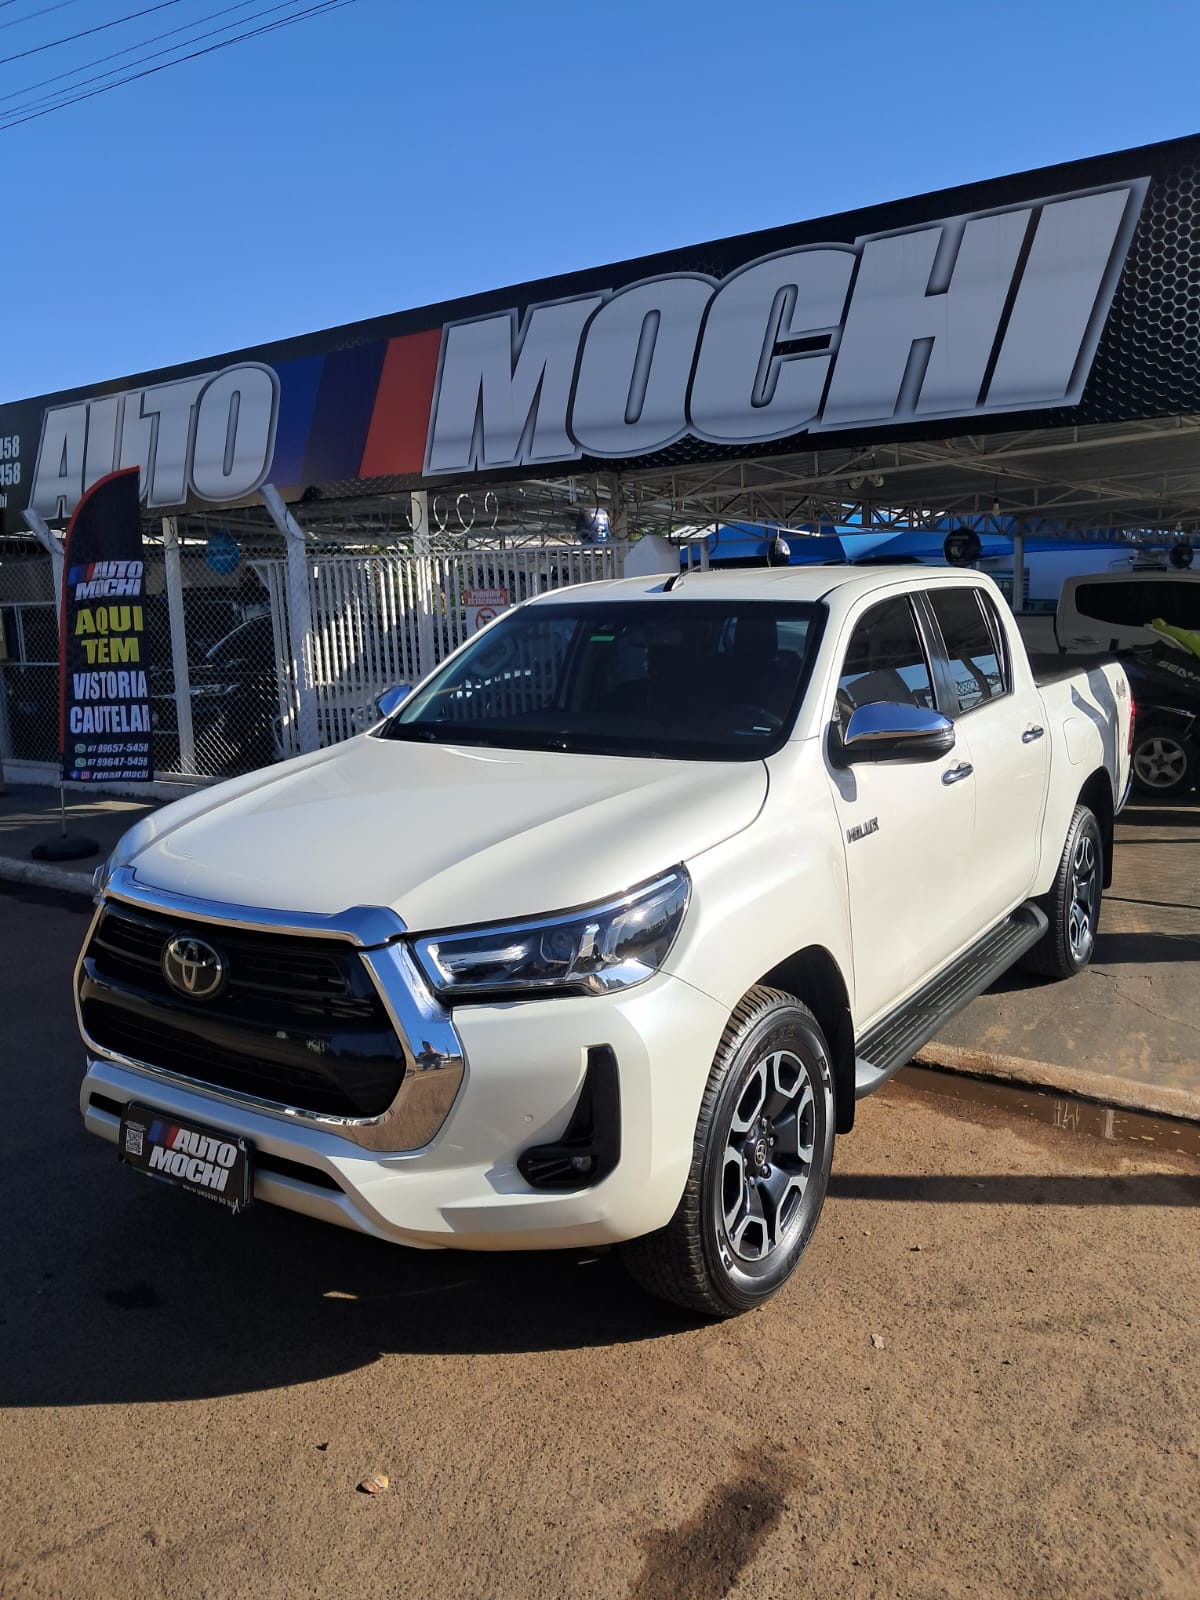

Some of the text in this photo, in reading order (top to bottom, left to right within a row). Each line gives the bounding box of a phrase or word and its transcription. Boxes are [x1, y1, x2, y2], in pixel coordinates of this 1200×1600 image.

[28, 176, 1151, 521] AUTO MOCHI
[91, 560, 144, 581] AUTO
[74, 578, 142, 601] MOCHI
[74, 605, 144, 636] AQUI
[80, 636, 141, 664] TEM
[73, 670, 148, 700] VISTORIA
[171, 1128, 238, 1168] AUTO
[148, 1145, 230, 1192] MOCHI
